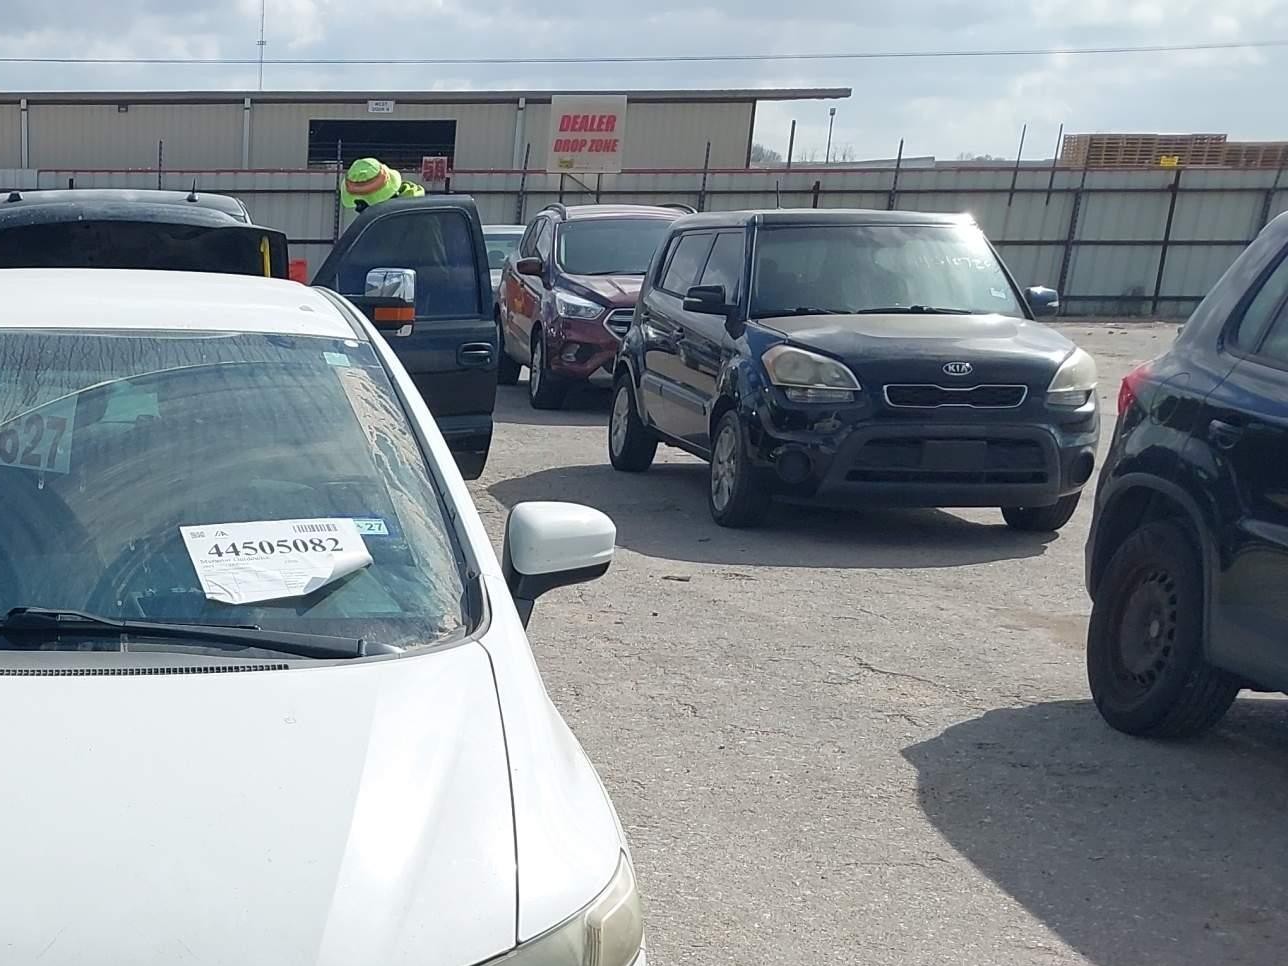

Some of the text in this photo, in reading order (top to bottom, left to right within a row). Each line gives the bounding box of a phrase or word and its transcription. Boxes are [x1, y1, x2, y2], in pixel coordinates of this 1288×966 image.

[559, 114, 617, 132] DEALER
[553, 139, 619, 152] DROP ZONE
[948, 363, 969, 373] KIA
[367, 521, 383, 532] 27
[207, 537, 344, 558] 44505082
